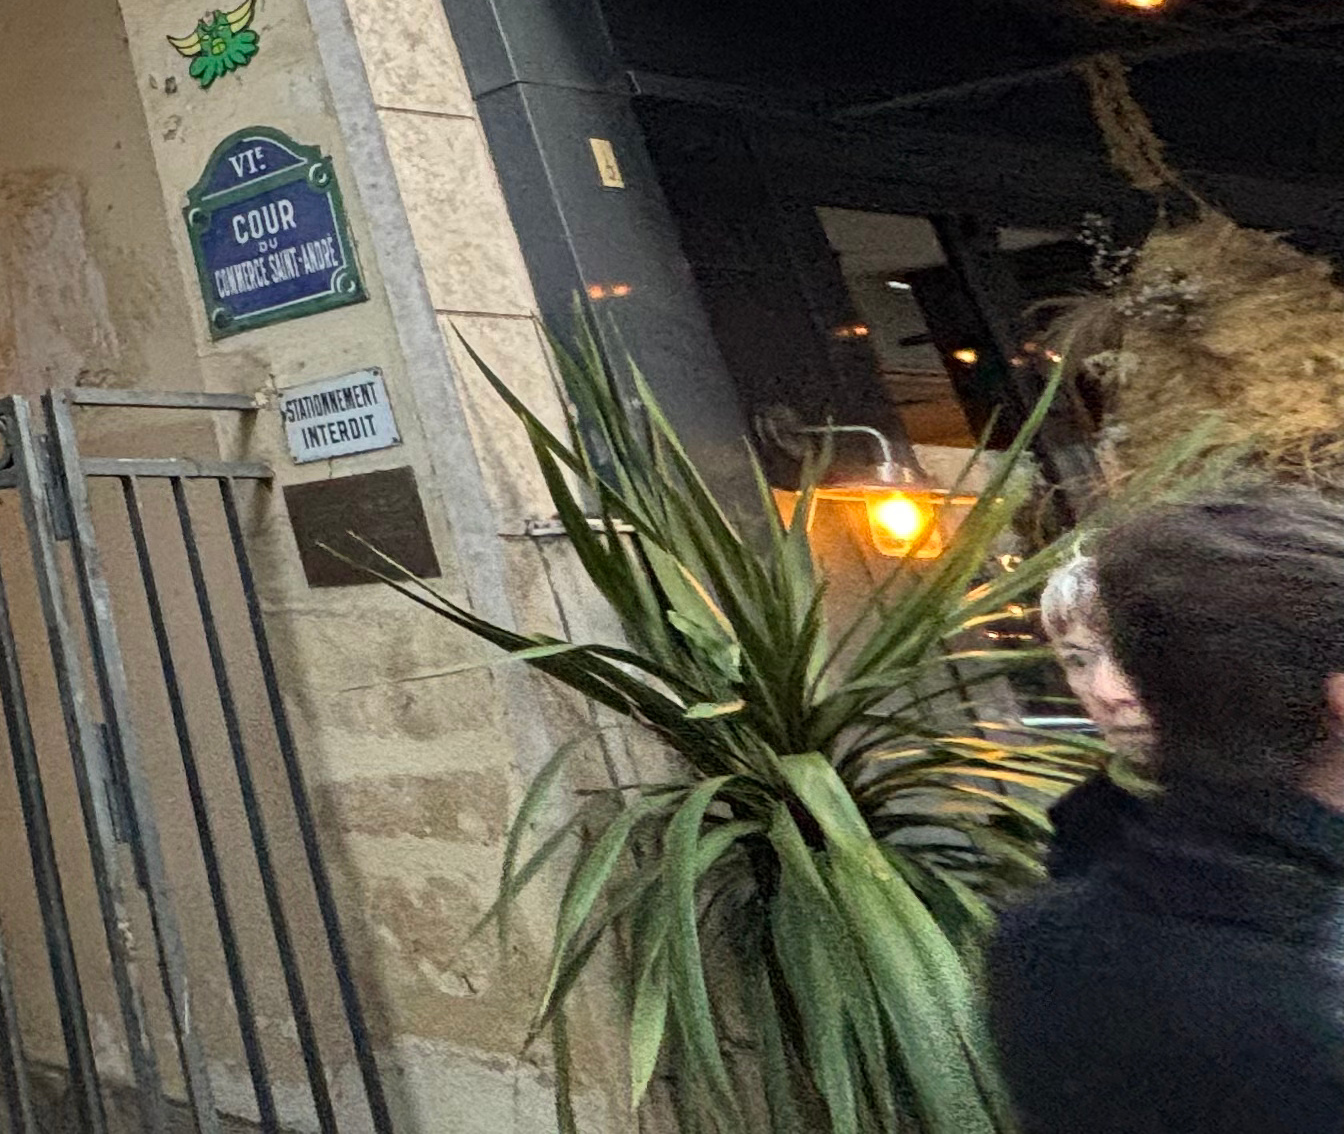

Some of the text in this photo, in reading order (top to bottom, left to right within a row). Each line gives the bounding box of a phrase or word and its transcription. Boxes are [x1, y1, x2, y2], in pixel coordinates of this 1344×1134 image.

[232, 199, 297, 244] COUR
[258, 237, 278, 253] DU
[214, 257, 270, 298] COMMERCE
[285, 382, 378, 423] STATIONNEMENT
[301, 414, 377, 449] INTERDIT
